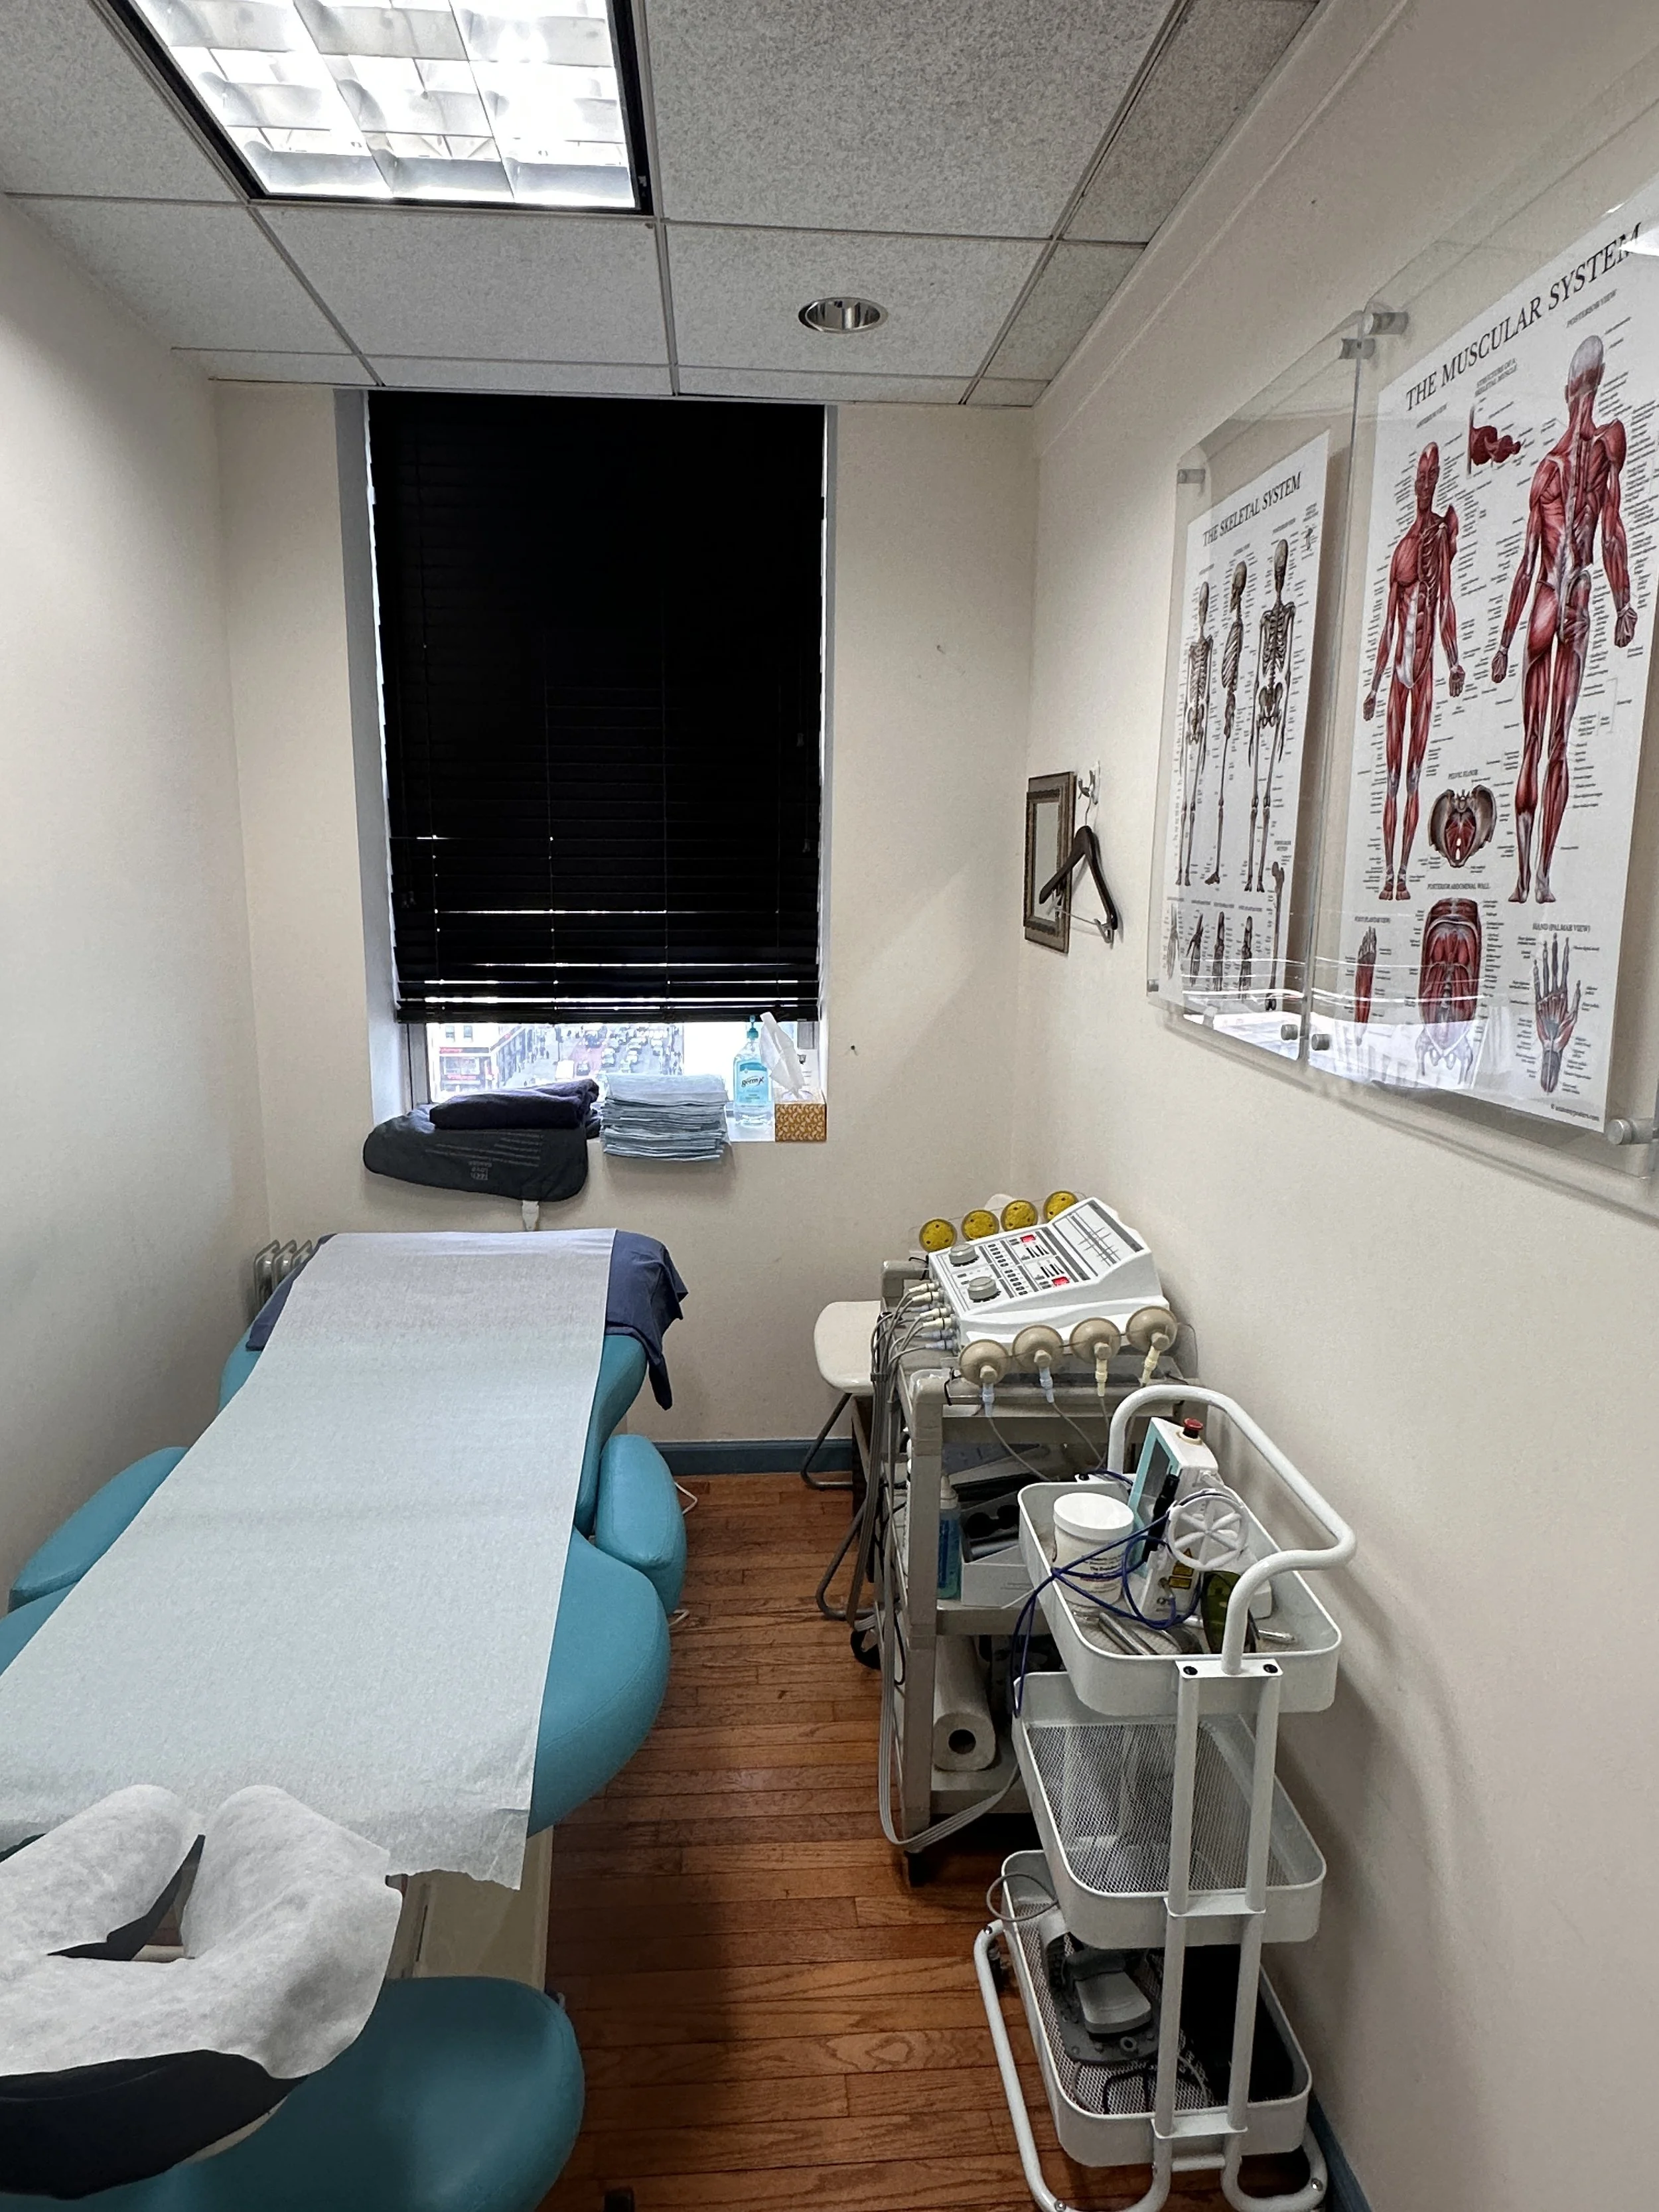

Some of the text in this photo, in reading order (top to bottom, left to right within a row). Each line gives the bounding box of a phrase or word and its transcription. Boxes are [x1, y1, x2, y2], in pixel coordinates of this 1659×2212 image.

[1406, 371, 1437, 411] THE
[1441, 296, 1542, 388] MUSCULAR
[1202, 524, 1219, 547] THE
[1220, 498, 1261, 537] SKELETAL
[1262, 471, 1302, 510] SYSTEM
